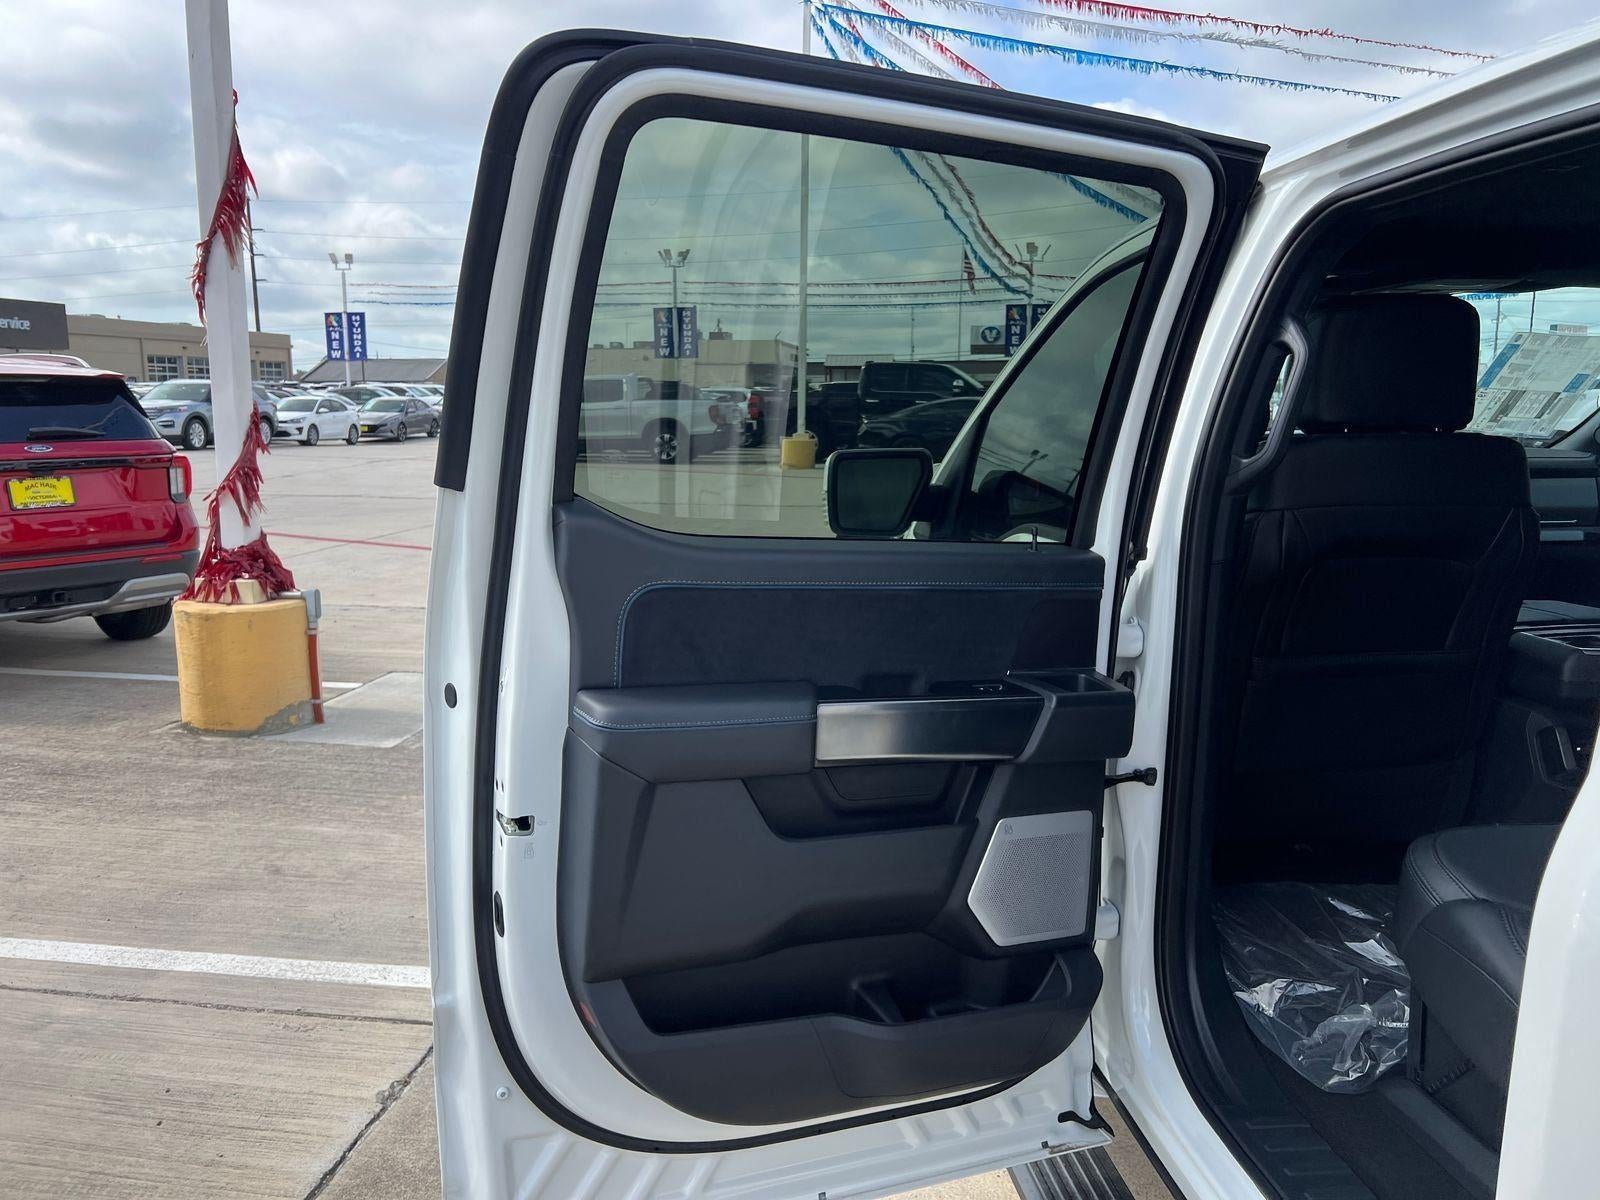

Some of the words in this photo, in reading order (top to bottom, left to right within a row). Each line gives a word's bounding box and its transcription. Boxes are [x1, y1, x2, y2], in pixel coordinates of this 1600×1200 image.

[331, 331, 341, 358] NEW
[351, 315, 362, 358] HYUNDAI
[659, 327, 670, 356] NEW
[682, 310, 692, 356] HYUNDAI
[25, 482, 38, 491] MAC
